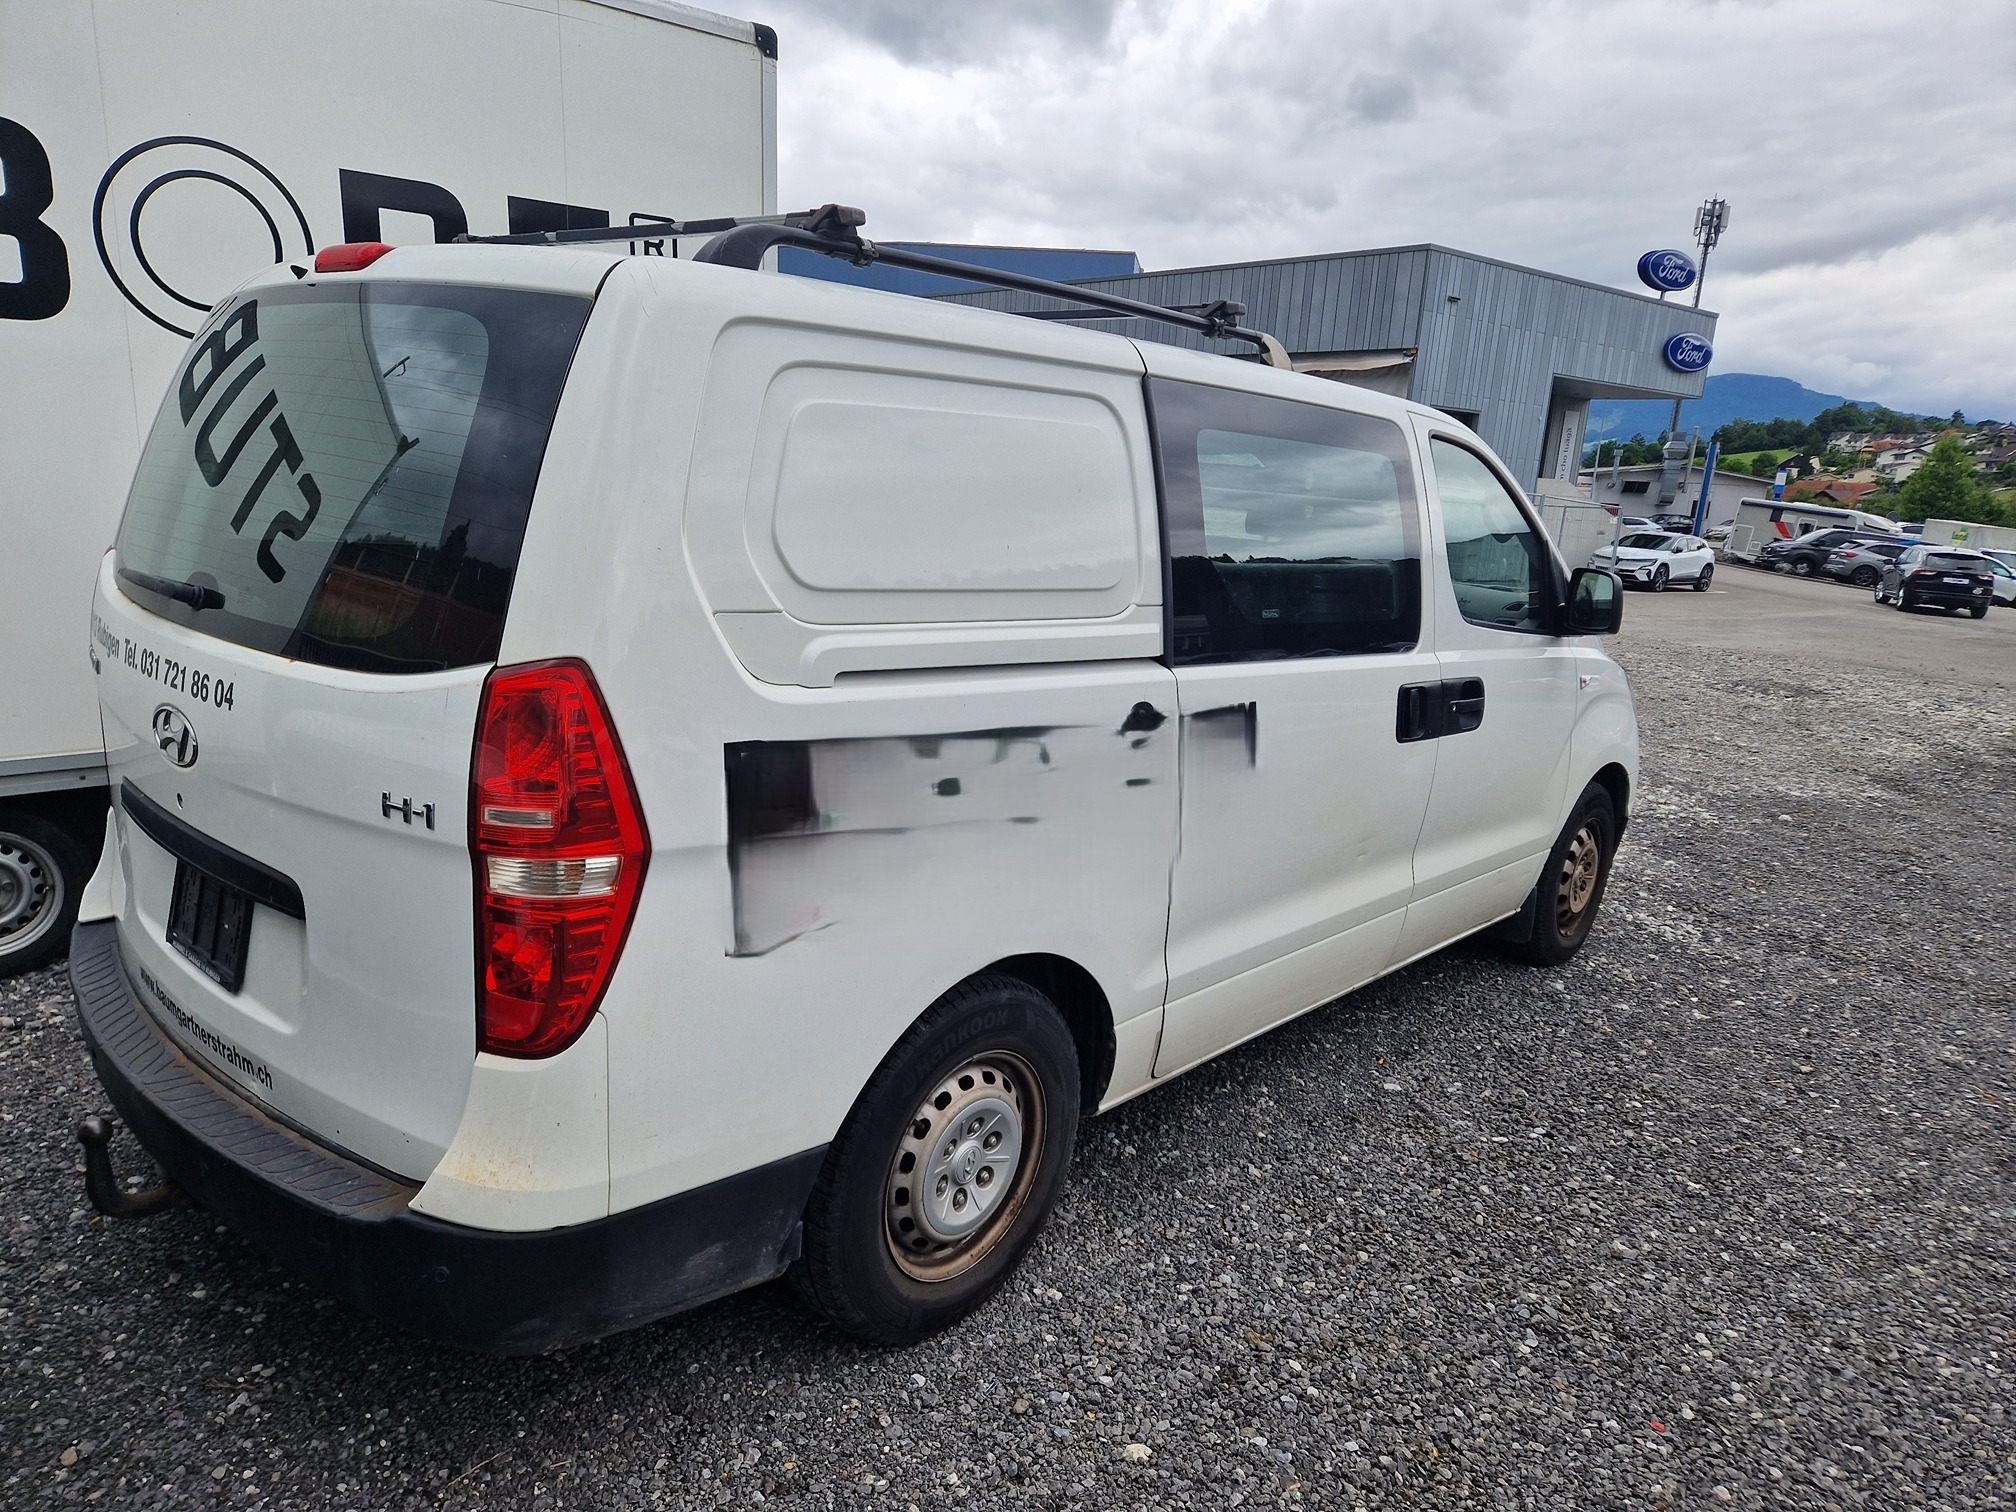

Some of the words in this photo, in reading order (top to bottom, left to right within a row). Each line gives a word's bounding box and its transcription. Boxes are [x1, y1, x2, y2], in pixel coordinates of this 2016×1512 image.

[1659, 254, 1689, 283] Ford
[1677, 337, 1705, 363] Ford
[124, 637, 138, 671] Tel.
[140, 648, 160, 681] 031
[163, 658, 187, 693] 721
[190, 669, 210, 703] 86
[214, 678, 235, 712] 04
[139, 965, 273, 1091] www.baumgartnerstrahm.ch
